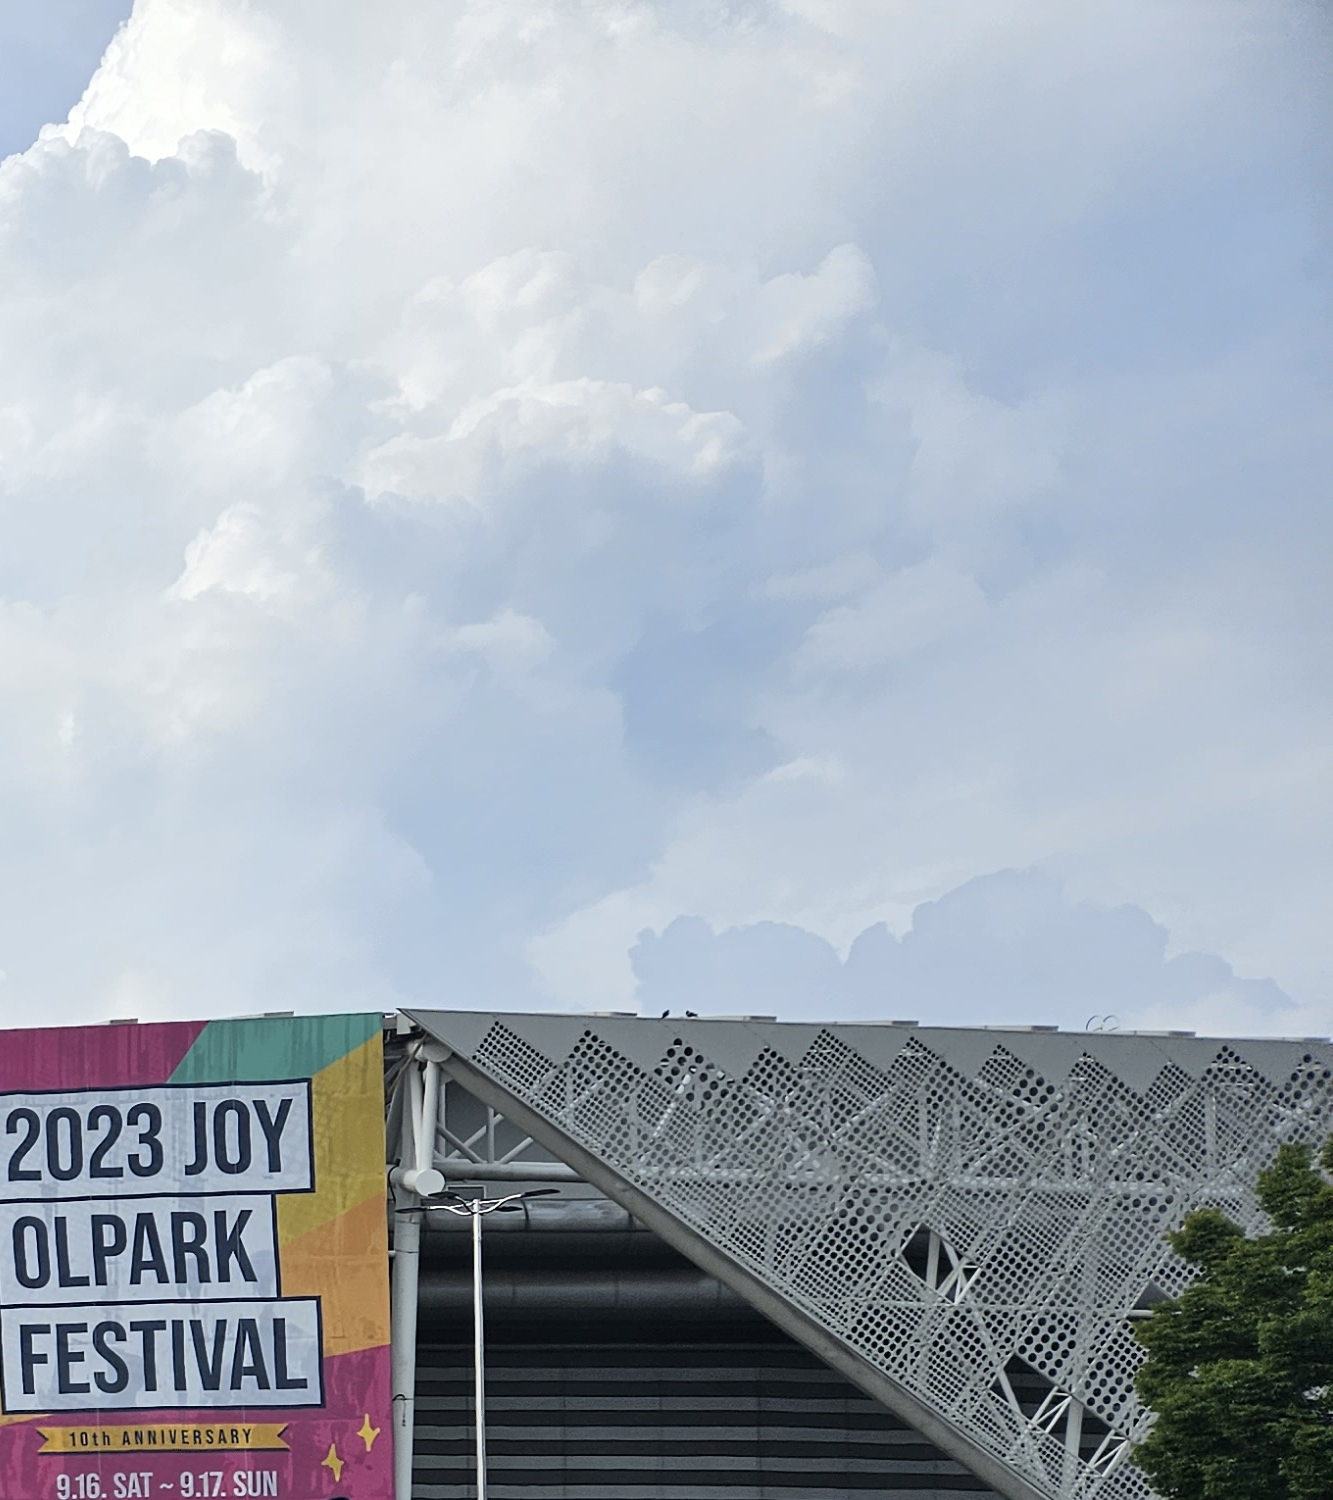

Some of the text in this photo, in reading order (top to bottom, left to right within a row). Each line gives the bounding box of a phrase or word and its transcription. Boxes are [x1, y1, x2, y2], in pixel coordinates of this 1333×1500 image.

[6, 1099, 293, 1182] 2023 JOY
[13, 1209, 258, 1289] OLPARK
[21, 1318, 307, 1395] FESTIVAL
[69, 1428, 252, 1447] 10th ANNIVERSARY
[56, 1472, 107, 1500] 9.16.
[113, 1471, 154, 1499] SAT
[180, 1470, 226, 1498] 9.17.
[233, 1469, 278, 1497] SUN
